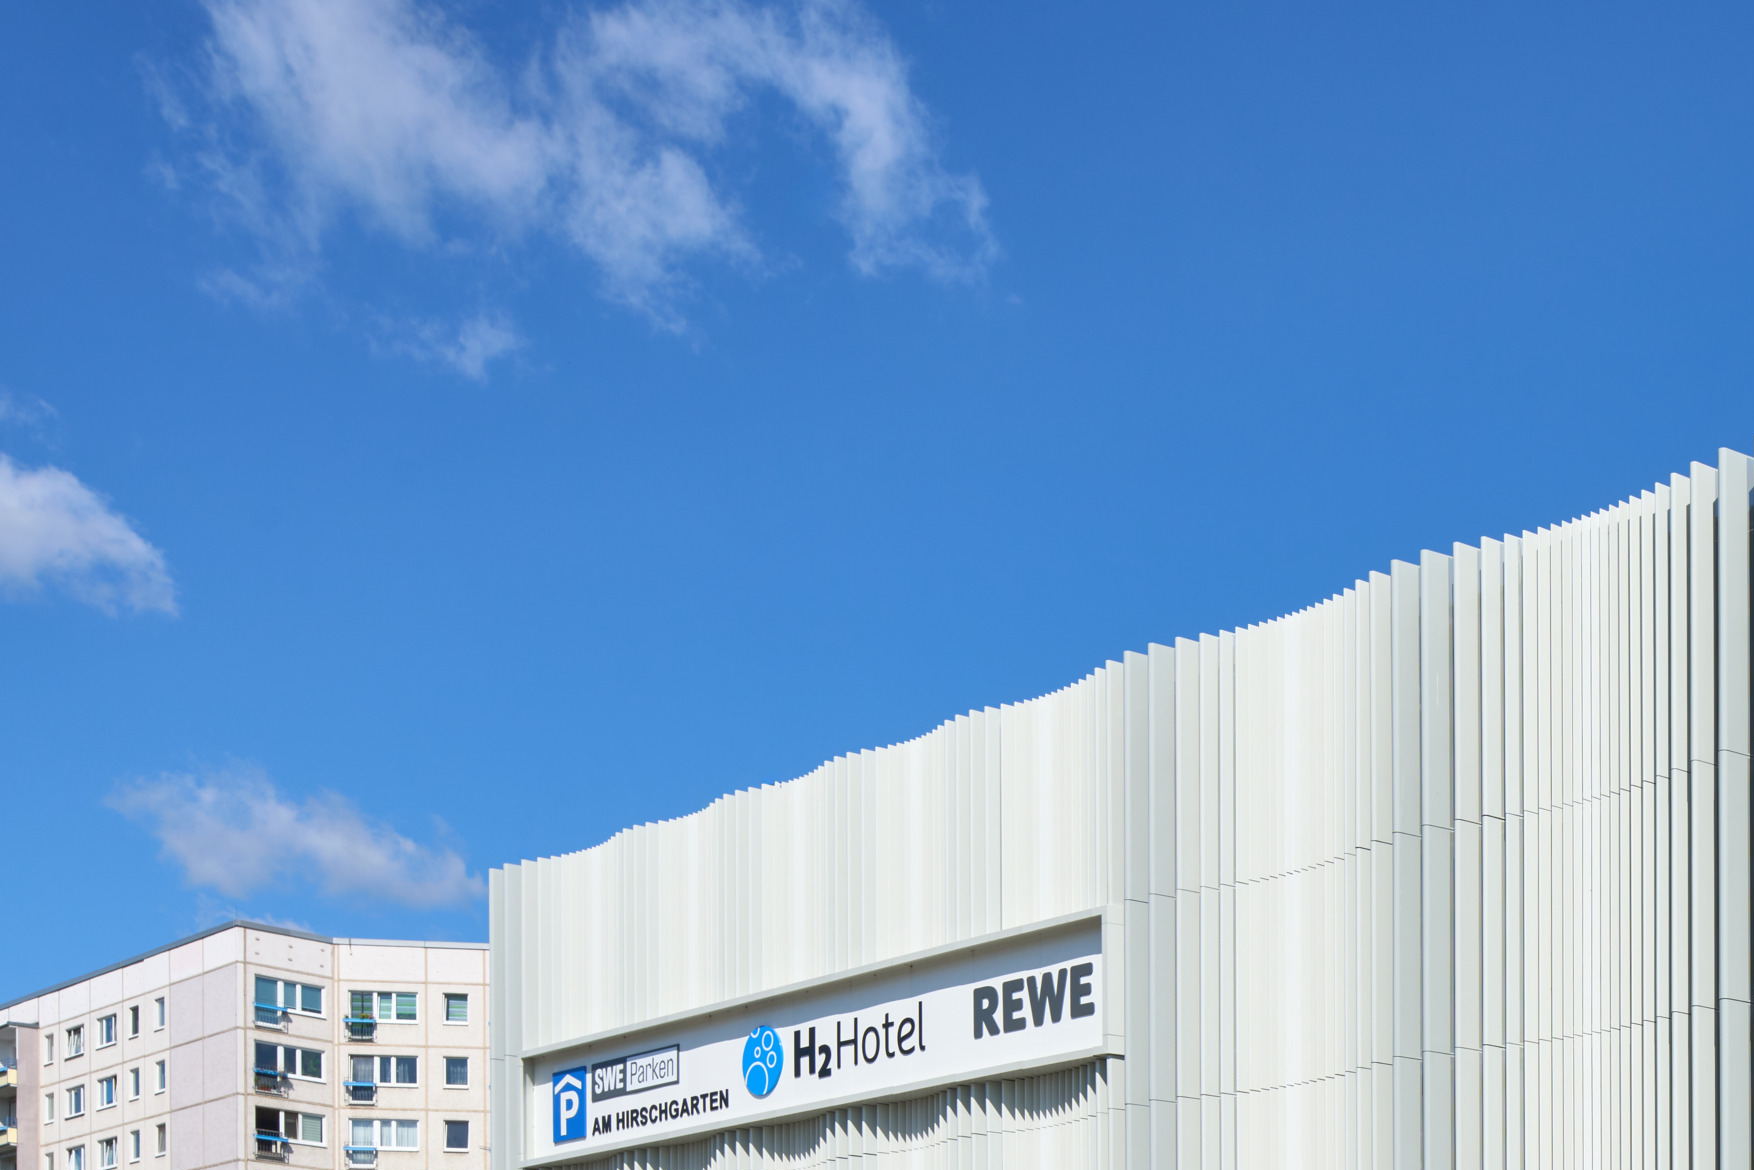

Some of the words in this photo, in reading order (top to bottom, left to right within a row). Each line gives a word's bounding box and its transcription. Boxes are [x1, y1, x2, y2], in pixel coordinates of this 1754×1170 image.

[973, 961, 1096, 1040] REWE
[793, 1000, 926, 1080] H2Hotel
[594, 1063, 625, 1095] SWE
[630, 1057, 674, 1085] Parken
[559, 1090, 580, 1137] P
[592, 1114, 612, 1136] AM
[616, 1089, 730, 1131] HIRSCHGARTEN
